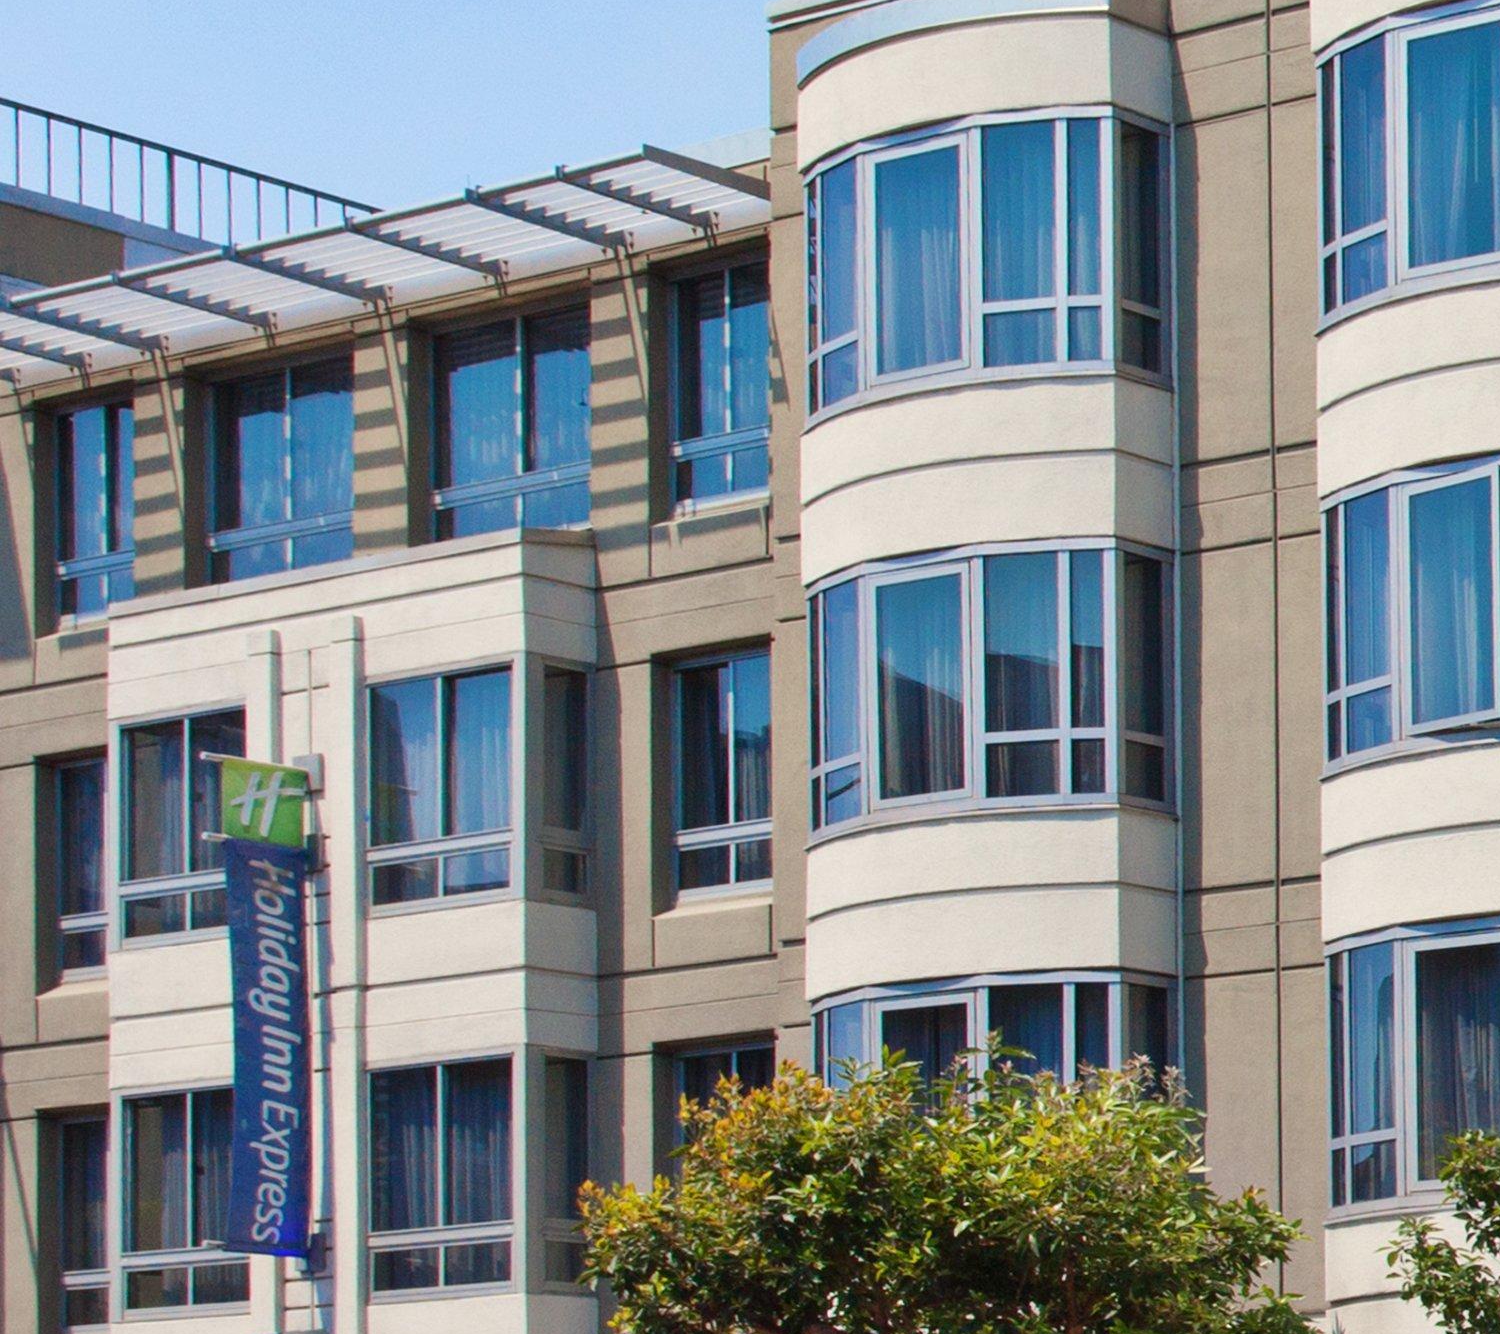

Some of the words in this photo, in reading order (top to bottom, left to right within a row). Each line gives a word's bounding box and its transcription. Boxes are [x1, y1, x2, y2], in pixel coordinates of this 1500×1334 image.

[248, 859, 300, 1022] Holiday
[262, 1025, 301, 1093] Inn
[250, 1099, 299, 1246] Express
